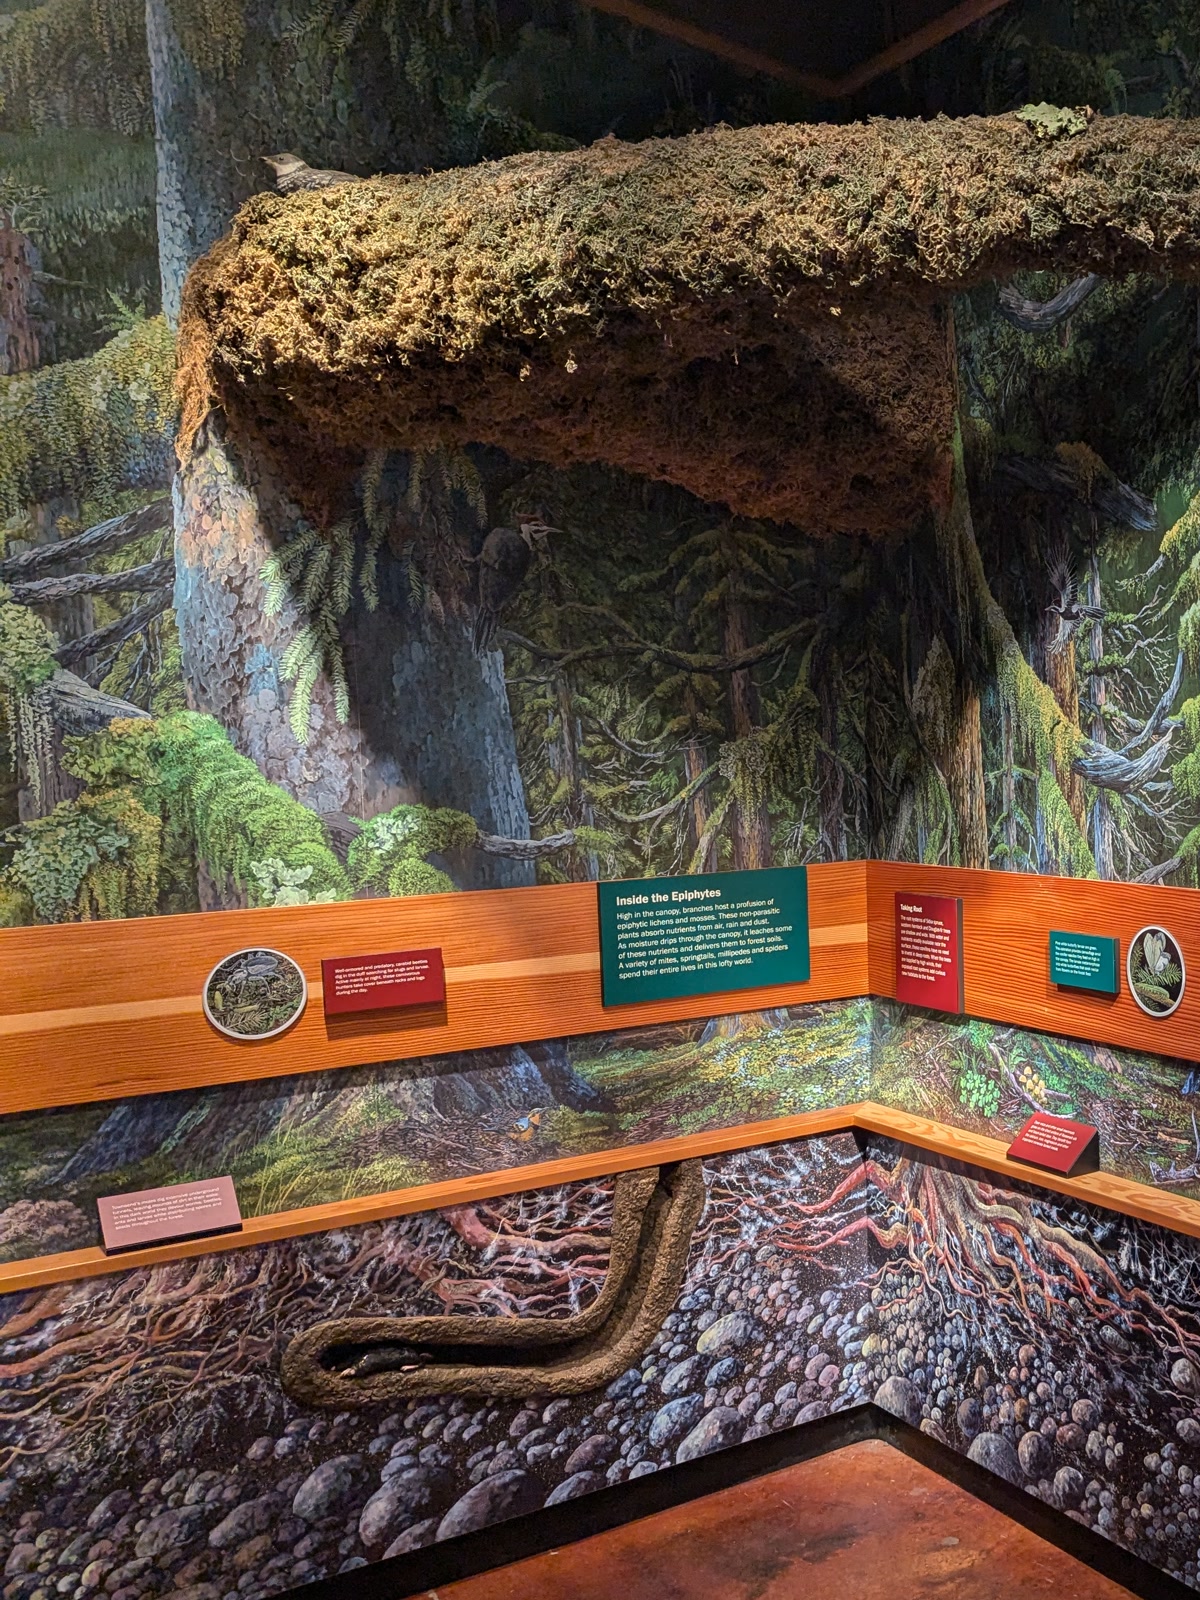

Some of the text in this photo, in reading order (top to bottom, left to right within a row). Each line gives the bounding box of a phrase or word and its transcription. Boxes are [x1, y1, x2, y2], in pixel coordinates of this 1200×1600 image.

[617, 889, 721, 906] Inside the Epiphytes
[617, 912, 632, 920] High
[736, 901, 766, 909] profusion
[617, 921, 648, 930] epiphytic
[740, 908, 780, 917] non-parasitic
